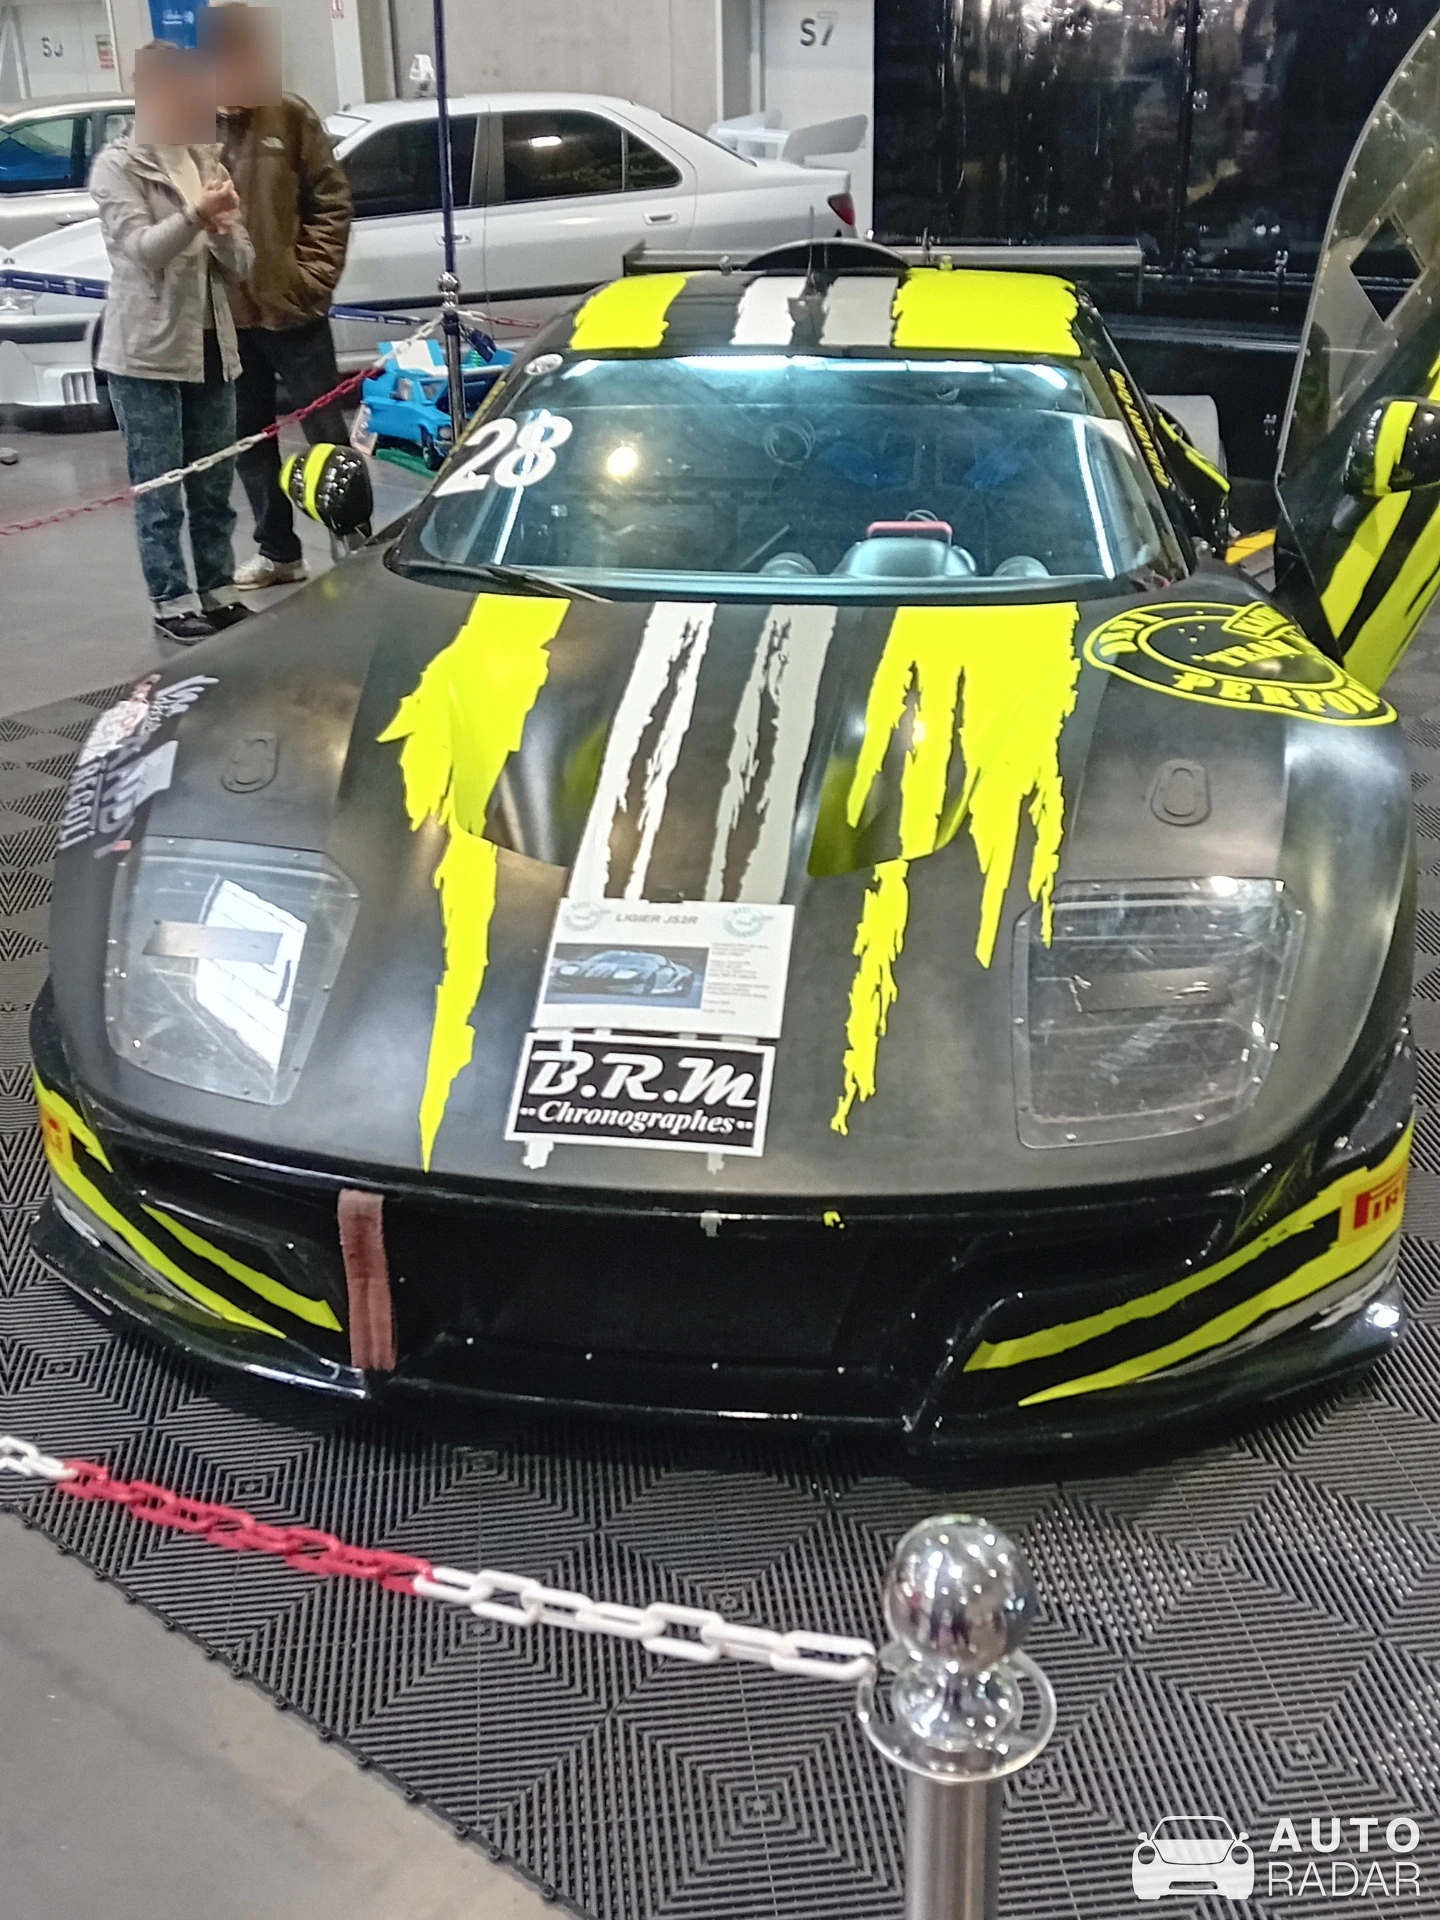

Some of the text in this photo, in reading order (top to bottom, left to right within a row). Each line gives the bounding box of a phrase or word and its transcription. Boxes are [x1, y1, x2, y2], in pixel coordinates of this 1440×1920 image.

[800, 10, 838, 47] S7
[432, 416, 573, 497] 28
[615, 912, 662, 925] LIGIER
[527, 1050, 757, 1108] B.R.M
